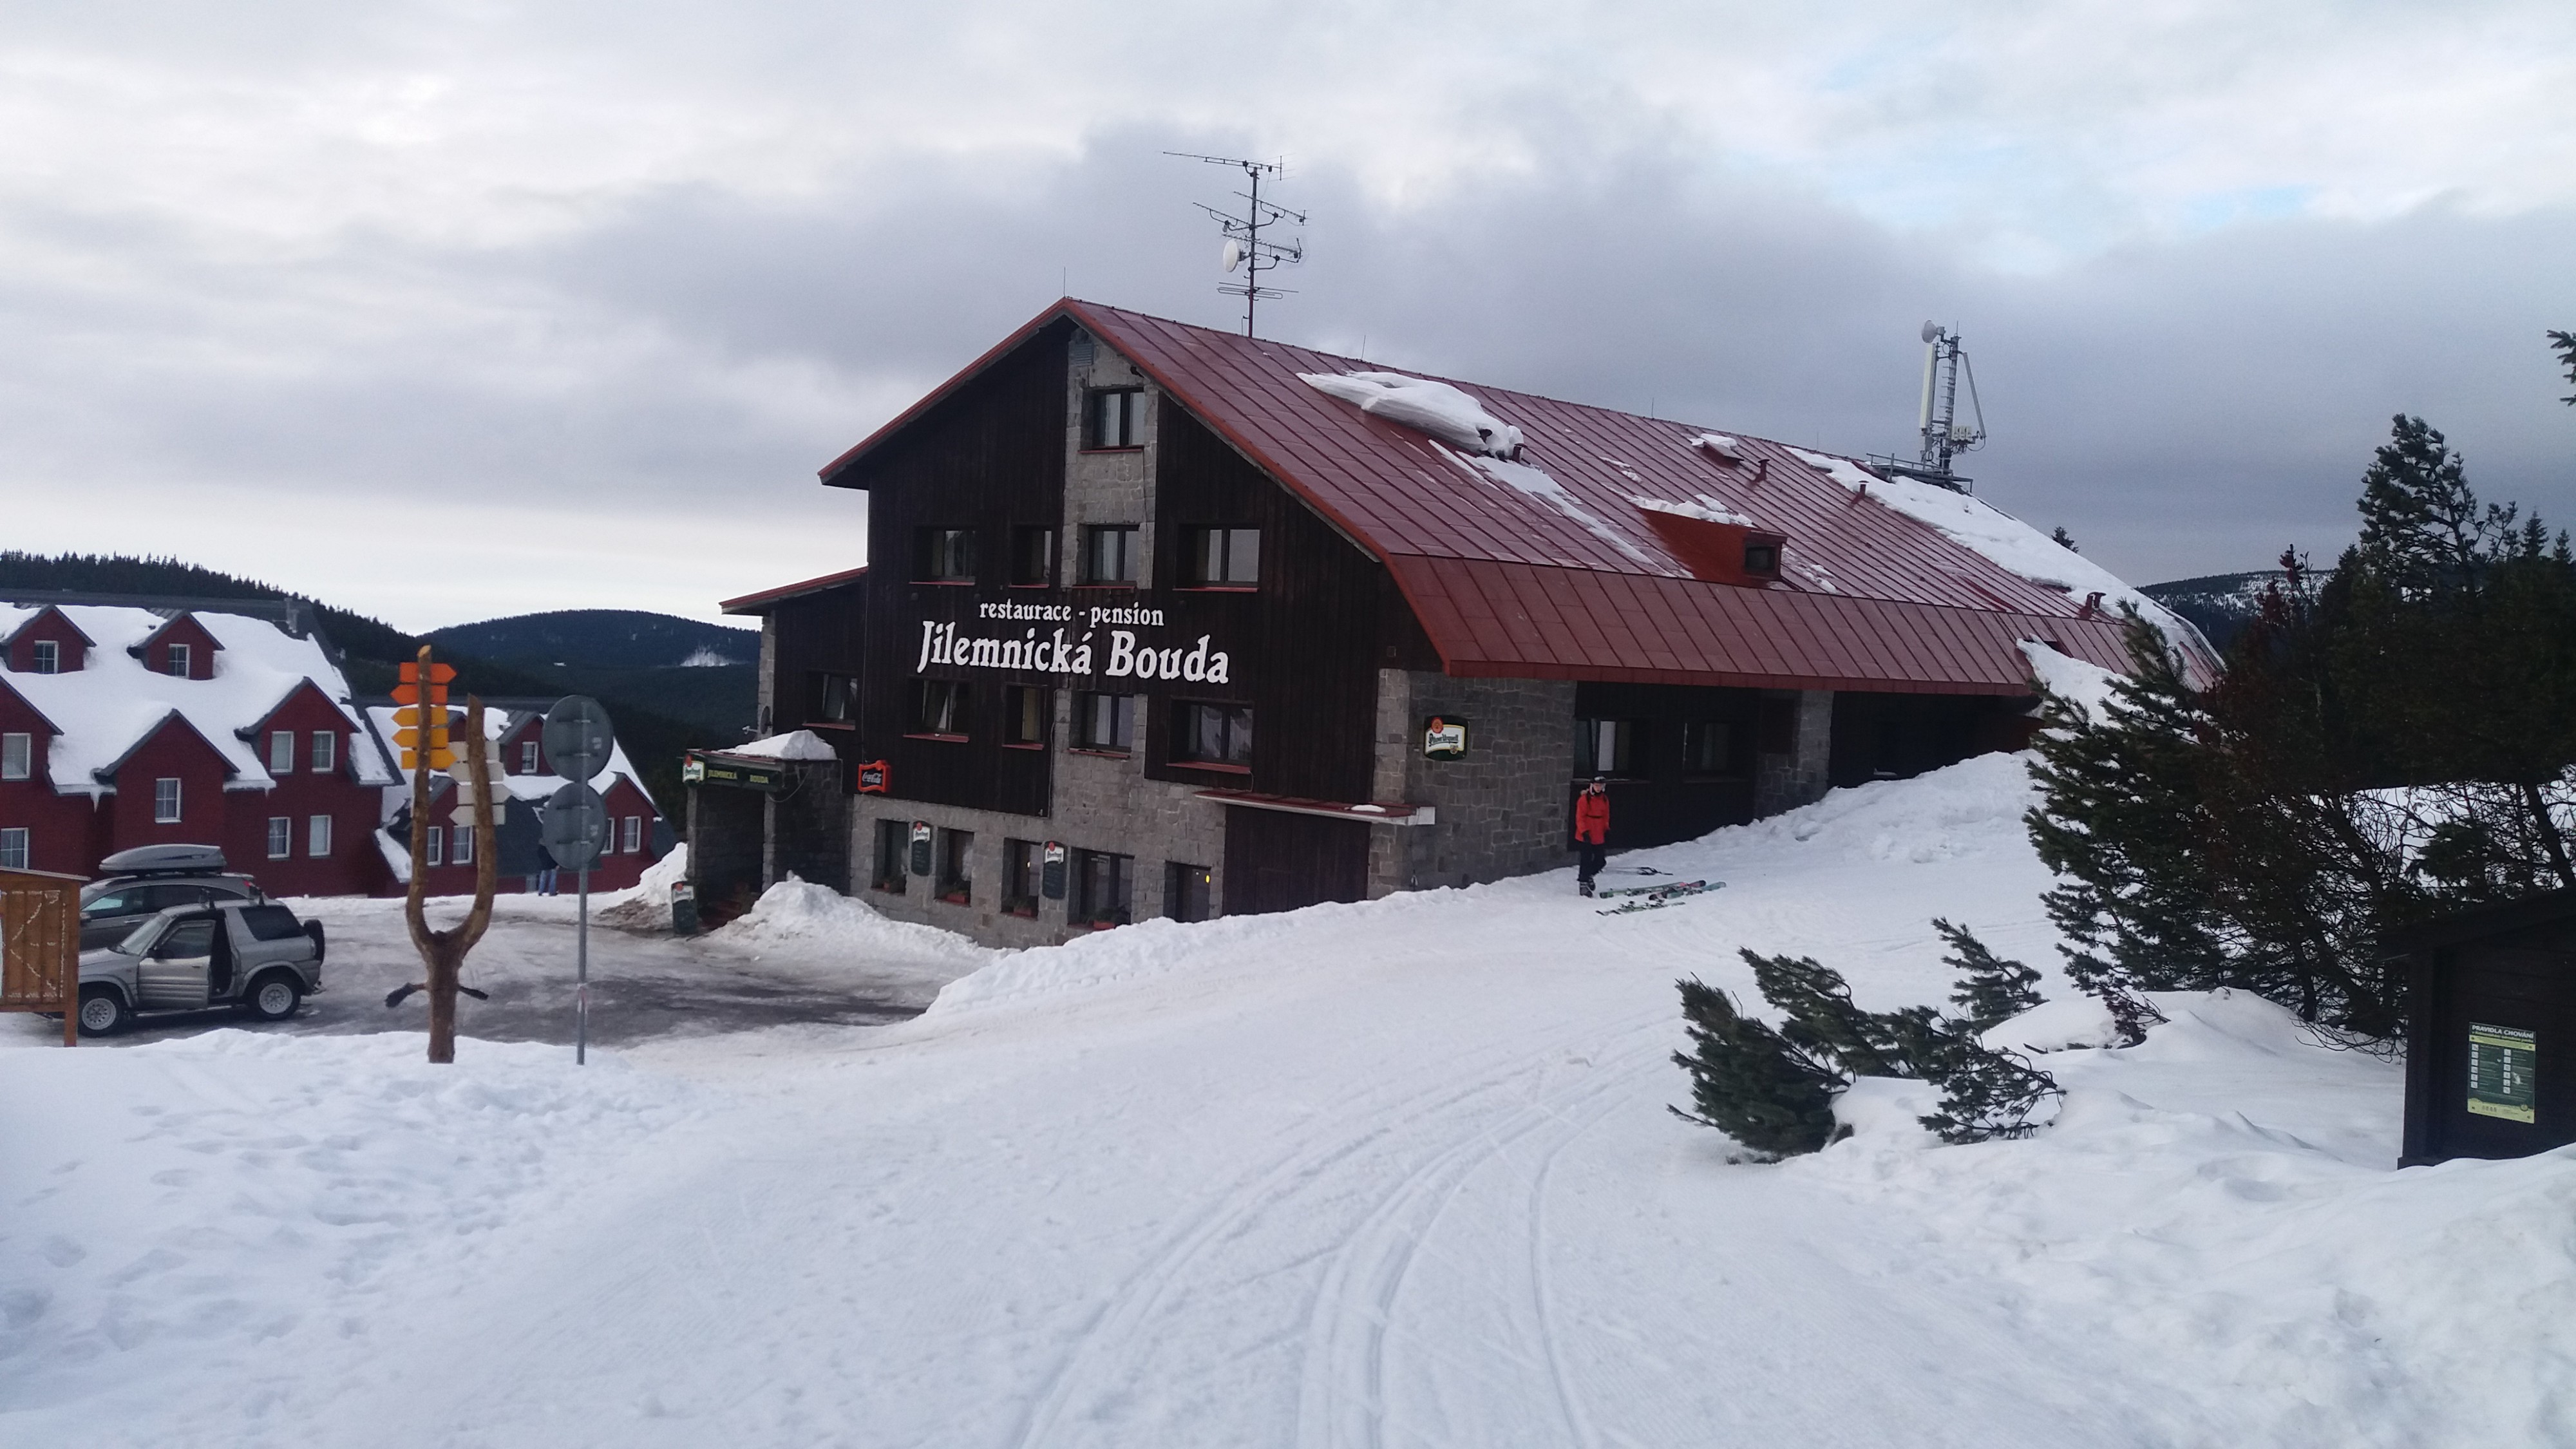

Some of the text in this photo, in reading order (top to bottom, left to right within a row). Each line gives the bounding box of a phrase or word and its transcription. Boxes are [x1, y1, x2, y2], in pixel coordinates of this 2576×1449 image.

[980, 598, 1072, 621] restaurace
[1090, 601, 1164, 628] pension
[917, 621, 1229, 684] Jilemnická Bouda
[2472, 1025, 2502, 1034] PRAVIDLA
